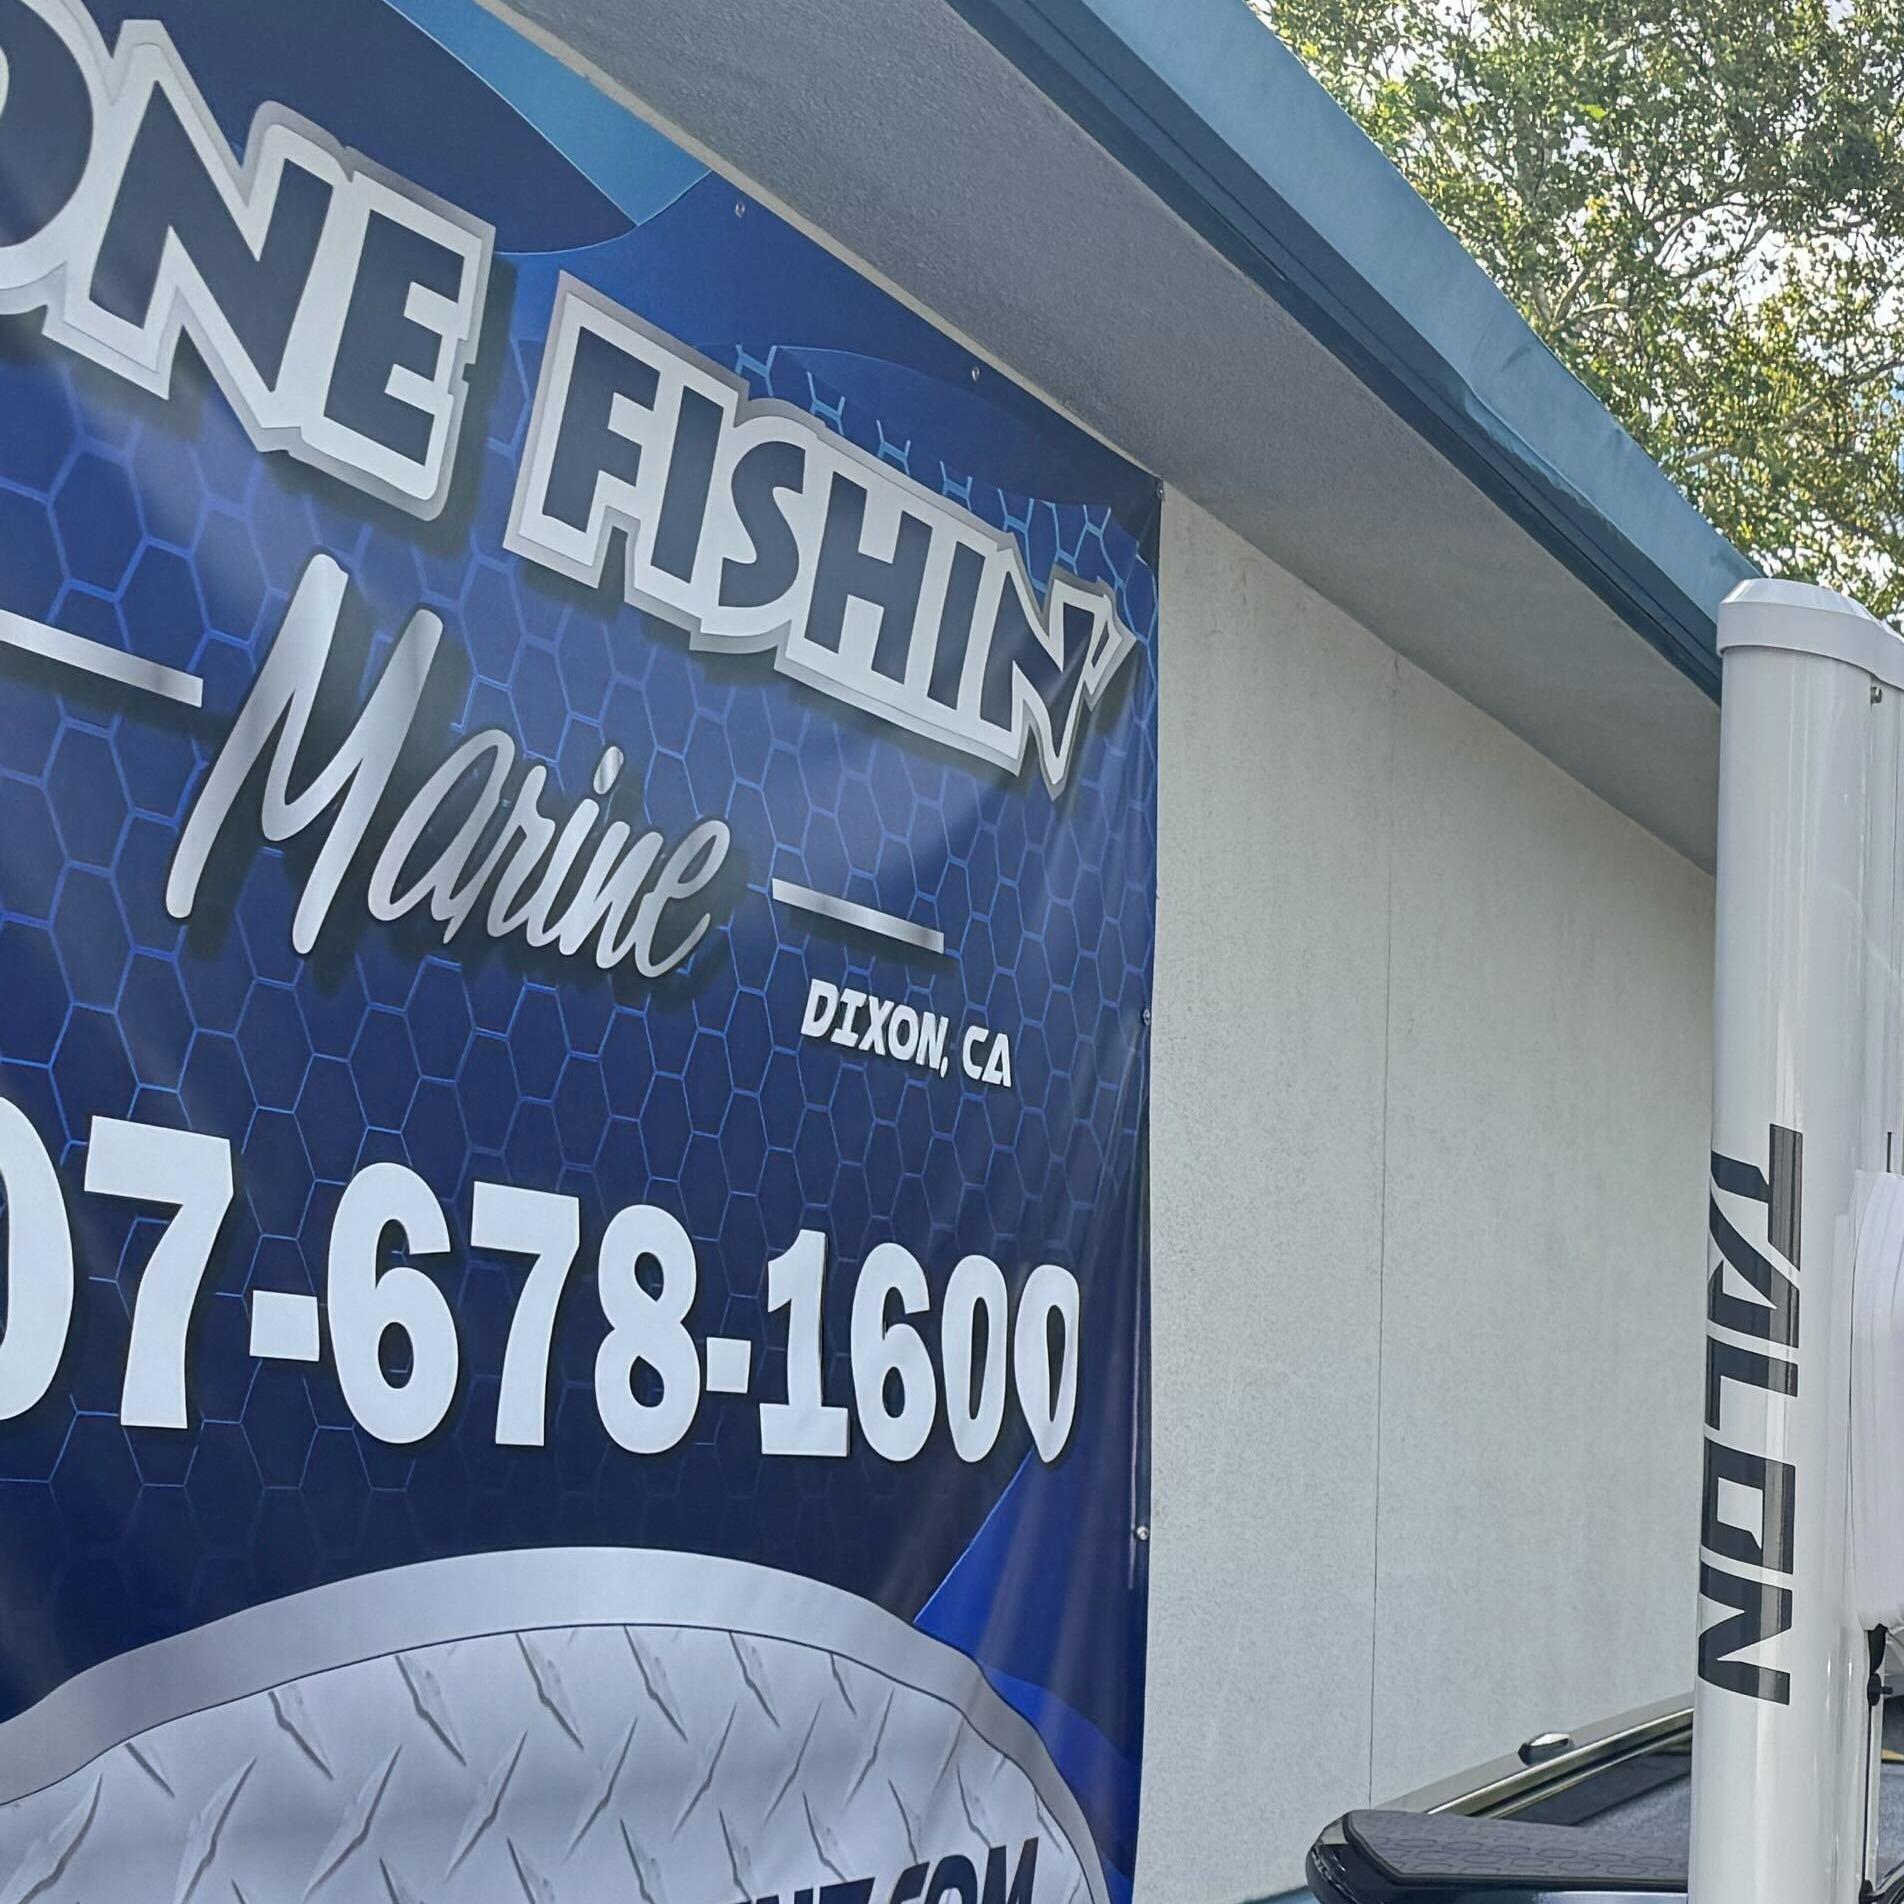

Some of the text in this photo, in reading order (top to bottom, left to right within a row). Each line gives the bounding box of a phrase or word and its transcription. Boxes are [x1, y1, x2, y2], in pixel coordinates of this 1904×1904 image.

[167, 553, 730, 978] Marine
[803, 978, 1014, 1088] DIXON, CA
[1698, 1124, 1803, 1706] TALON
